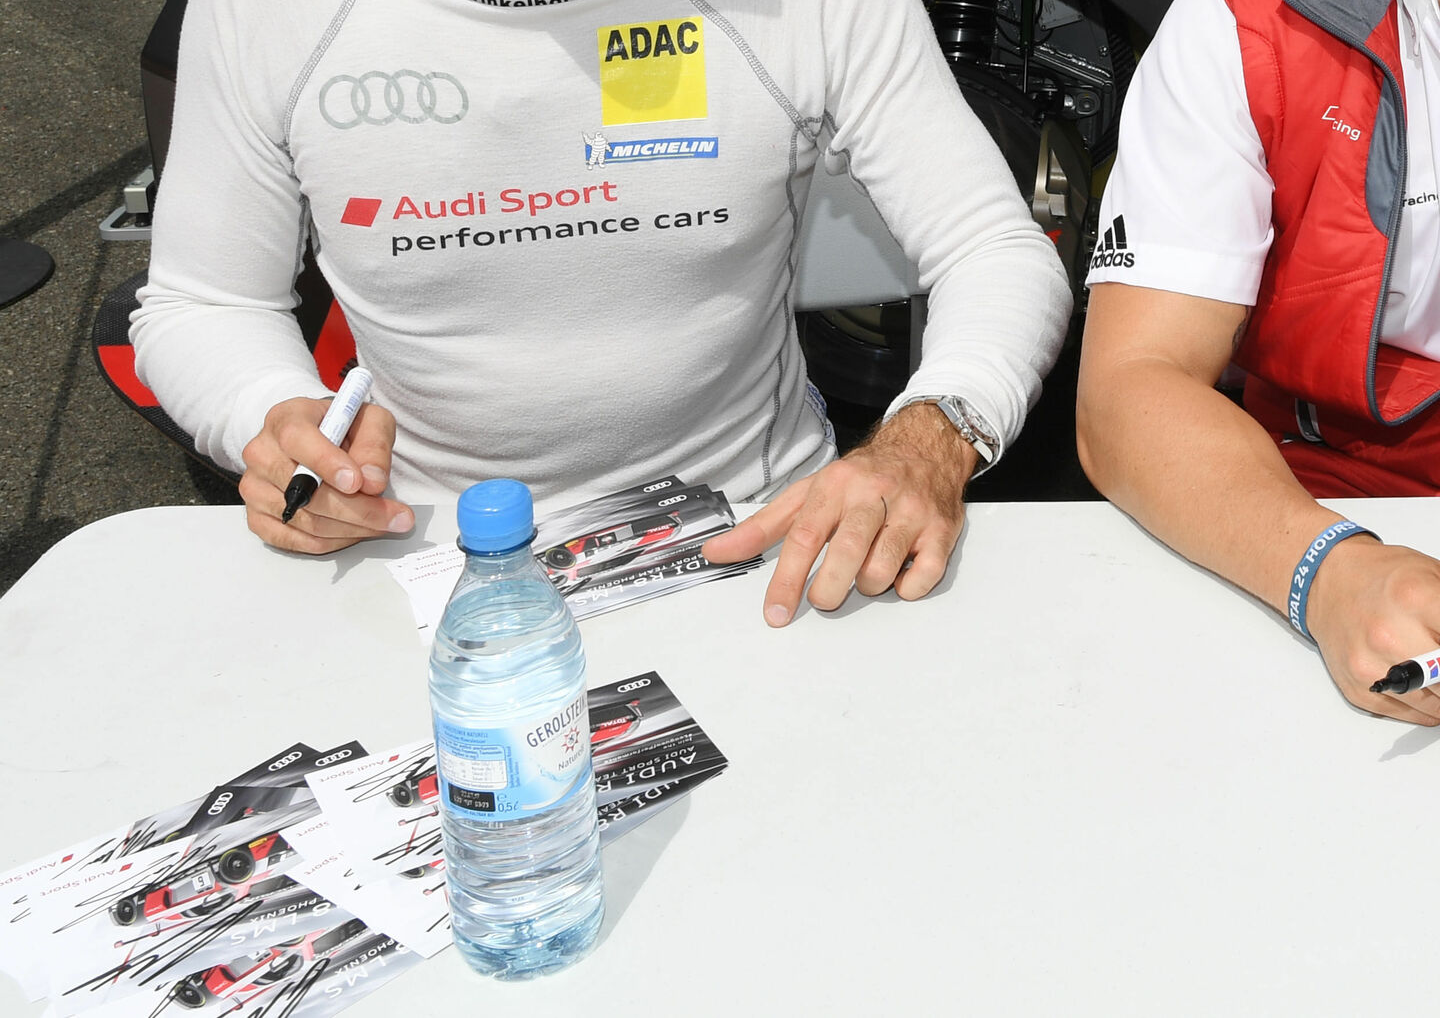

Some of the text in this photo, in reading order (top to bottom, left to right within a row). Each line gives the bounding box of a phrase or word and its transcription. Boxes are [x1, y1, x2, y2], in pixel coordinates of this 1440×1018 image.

[604, 21, 699, 62] ADAC
[1332, 119, 1361, 141] cing
[612, 140, 714, 156] MICHELIN
[392, 181, 618, 220] Audi Sport
[1402, 192, 1439, 207] racin
[391, 206, 730, 256] performance cars
[1091, 252, 1135, 270] adidas
[1295, 520, 1358, 590] 24 HOURS
[622, 745, 695, 774] AUDI SPORT
[626, 752, 697, 785] AUDI
[251, 897, 318, 924] PHOENIX
[230, 912, 298, 946] LMS
[334, 939, 395, 975] PHOENIX
[324, 955, 387, 998] LMS
